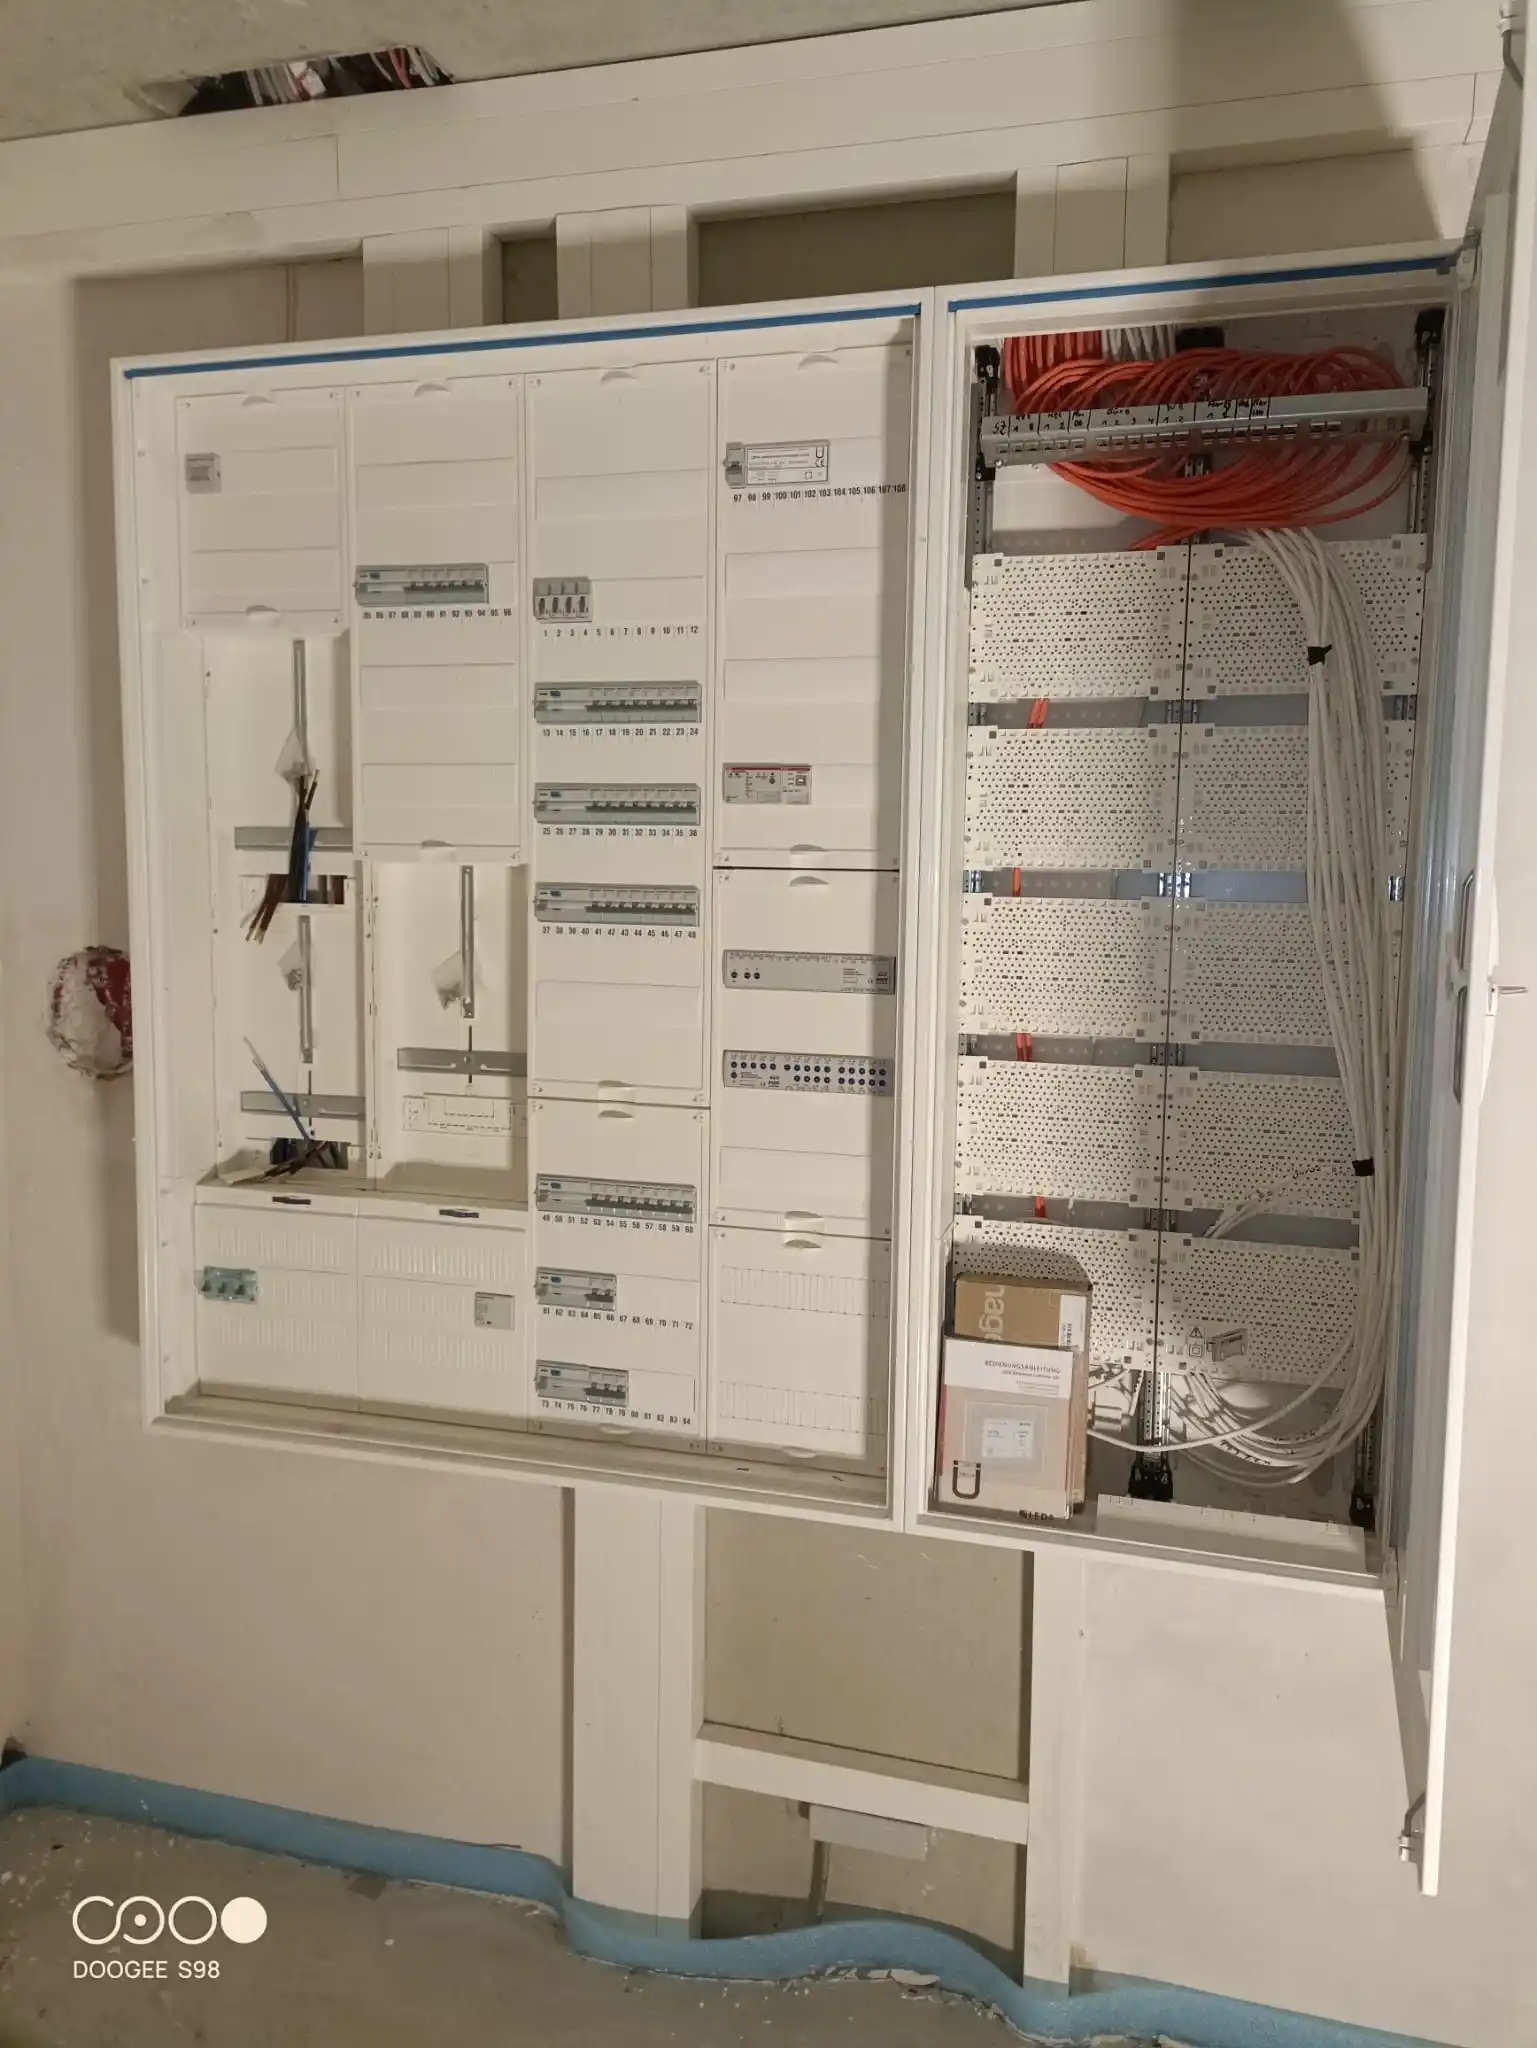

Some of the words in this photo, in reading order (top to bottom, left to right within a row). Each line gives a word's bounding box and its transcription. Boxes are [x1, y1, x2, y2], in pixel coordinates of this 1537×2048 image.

[733, 494, 742, 502] 97
[747, 493, 756, 502] 98
[762, 492, 771, 501] 99
[774, 491, 787, 500] 100
[790, 490, 801, 499] 101
[804, 489, 816, 498] 102
[819, 488, 831, 497] 103
[833, 488, 846, 496] 104
[848, 486, 861, 495] 105
[863, 486, 876, 495] 106
[878, 484, 893, 493] 107
[893, 484, 906, 493] 108
[663, 626, 670, 635] 10
[677, 626, 684, 635] 11
[690, 625, 698, 634] 12
[543, 729, 551, 737] 13
[569, 729, 577, 737] 15
[582, 728, 590, 736] 16
[595, 728, 603, 736] 17
[609, 728, 616, 736] 18
[621, 728, 630, 736] 19
[635, 728, 644, 736] 20
[649, 728, 657, 736] 21
[662, 728, 671, 736] 22
[676, 728, 685, 736] 23
[690, 728, 699, 736] 24
[543, 827, 551, 835] 25
[556, 827, 564, 836] 26
[568, 827, 577, 836] 27
[582, 828, 590, 836] 28
[595, 828, 603, 836] 29
[608, 828, 617, 836] 30
[622, 828, 629, 836] 31
[635, 828, 643, 836] 32
[648, 828, 657, 836] 33
[661, 829, 670, 837] 34
[675, 829, 684, 837] 35
[689, 829, 698, 837] 36
[542, 926, 551, 934] 37
[555, 926, 563, 934] 38
[568, 927, 576, 935] 39
[607, 928, 615, 936] 42
[661, 930, 669, 938] 46
[674, 930, 683, 938] 47
[688, 931, 696, 939] 48
[542, 1214, 550, 1222] 49
[554, 1215, 563, 1223] 50
[568, 1216, 575, 1224] 51
[580, 1217, 588, 1225] 52
[593, 1218, 601, 1226] 53
[606, 1219, 614, 1227] 54
[619, 1220, 627, 1228] 55
[632, 1221, 640, 1229] 56
[645, 1222, 654, 1230] 57
[658, 1223, 667, 1232] 58
[672, 1224, 680, 1232] 59
[543, 1307, 550, 1315] 61
[555, 1308, 563, 1316] 62
[593, 1312, 601, 1320] 65
[606, 1313, 614, 1321] 66
[619, 1315, 628, 1323] 67
[632, 1316, 640, 1324] 68
[645, 1317, 654, 1325] 69
[659, 1319, 667, 1327] 70
[672, 1320, 679, 1328] 71
[685, 1322, 693, 1330] 72
